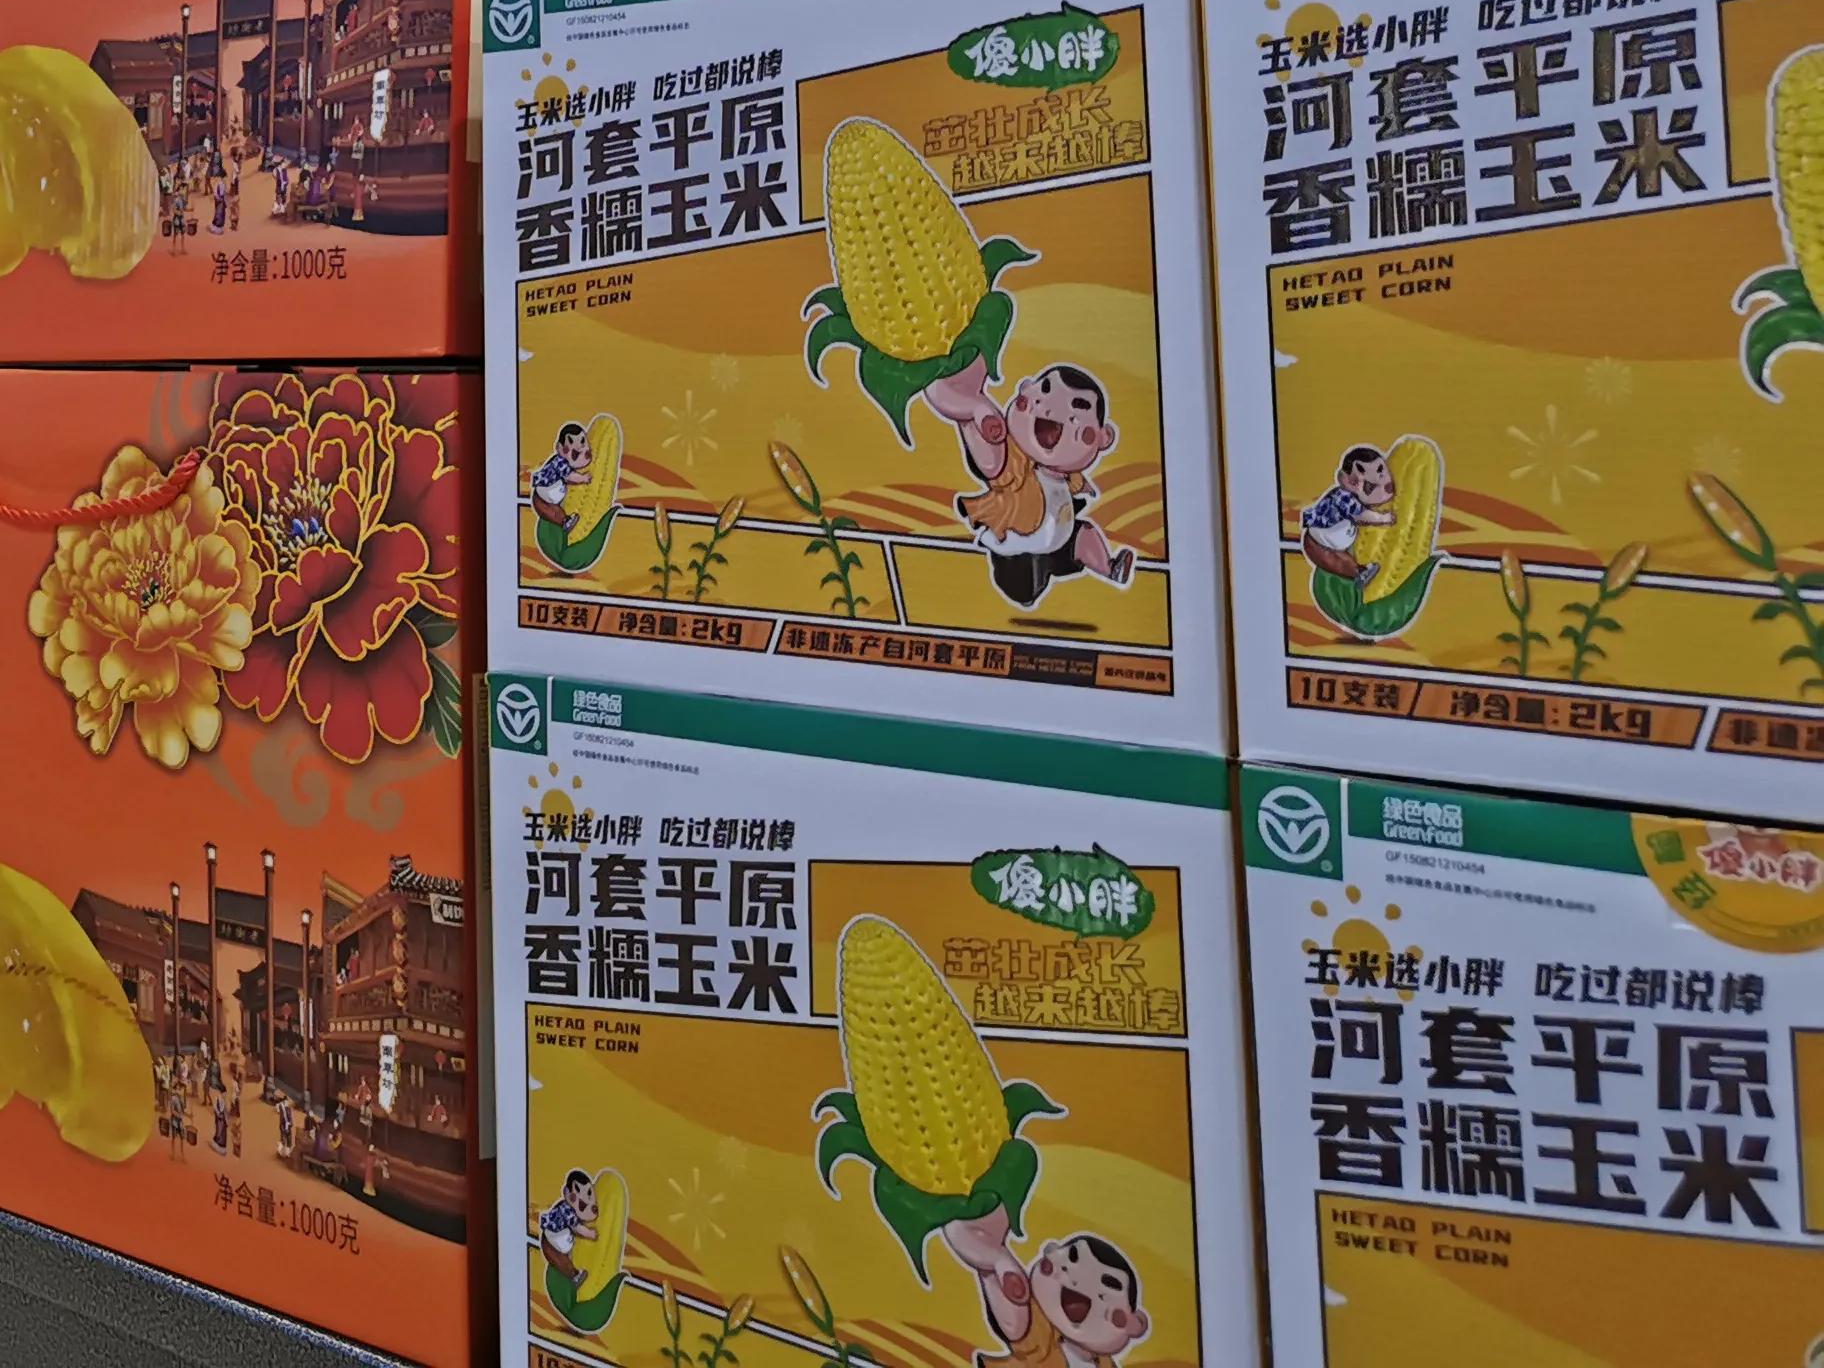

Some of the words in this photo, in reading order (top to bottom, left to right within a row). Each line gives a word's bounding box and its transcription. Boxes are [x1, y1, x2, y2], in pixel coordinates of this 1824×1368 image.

[964, 23, 1106, 79] 傻小胖
[1258, 6, 1451, 76] 玉米选小胖
[516, 79, 638, 133] 玉米选小胖
[652, 47, 784, 103] 吃过都说棒
[1262, 9, 1703, 162] 河套平原
[516, 94, 787, 200] 河套平原
[922, 85, 1114, 158] 茁壮成长
[952, 120, 1145, 191] 越来越棒
[1262, 105, 1708, 256] 香糯玉米
[516, 162, 788, 273] 香糯玉米
[524, 281, 578, 303] HETAO
[585, 272, 635, 295] PLAIN
[525, 297, 578, 319] SWEET
[587, 288, 633, 310] CORN
[1282, 266, 1364, 292] HETAO
[1378, 254, 1455, 280] PLAIN
[1284, 286, 1366, 311] SWEET
[1381, 276, 1452, 299] CORN
[526, 603, 590, 629] 10支装
[1300, 677, 1402, 709] 10支装
[522, 813, 643, 848] 玉米选小胖
[658, 816, 796, 854] 吃过都说棒
[524, 851, 798, 932] 河套平原
[989, 855, 1140, 928] 傻小胖
[524, 924, 799, 1015] 香糯玉米
[942, 938, 1145, 986] 茁壮成长
[1303, 947, 1506, 997] 玉米选小胖
[1534, 962, 1766, 1016] 吃过都说棒
[534, 1014, 587, 1033] HETAO
[593, 1019, 642, 1038] PLAIN
[973, 982, 1180, 1032] 越来越棒
[535, 1031, 587, 1049] SWEET
[594, 1036, 640, 1055] CORN
[1309, 997, 1776, 1121] 河套平原
[1309, 1090, 1781, 1232] 香糯玉米
[1332, 1208, 1416, 1234] HETAO
[1432, 1219, 1512, 1246] PLAIN
[1334, 1232, 1419, 1257] SWEET
[1435, 1241, 1510, 1269] CORN
